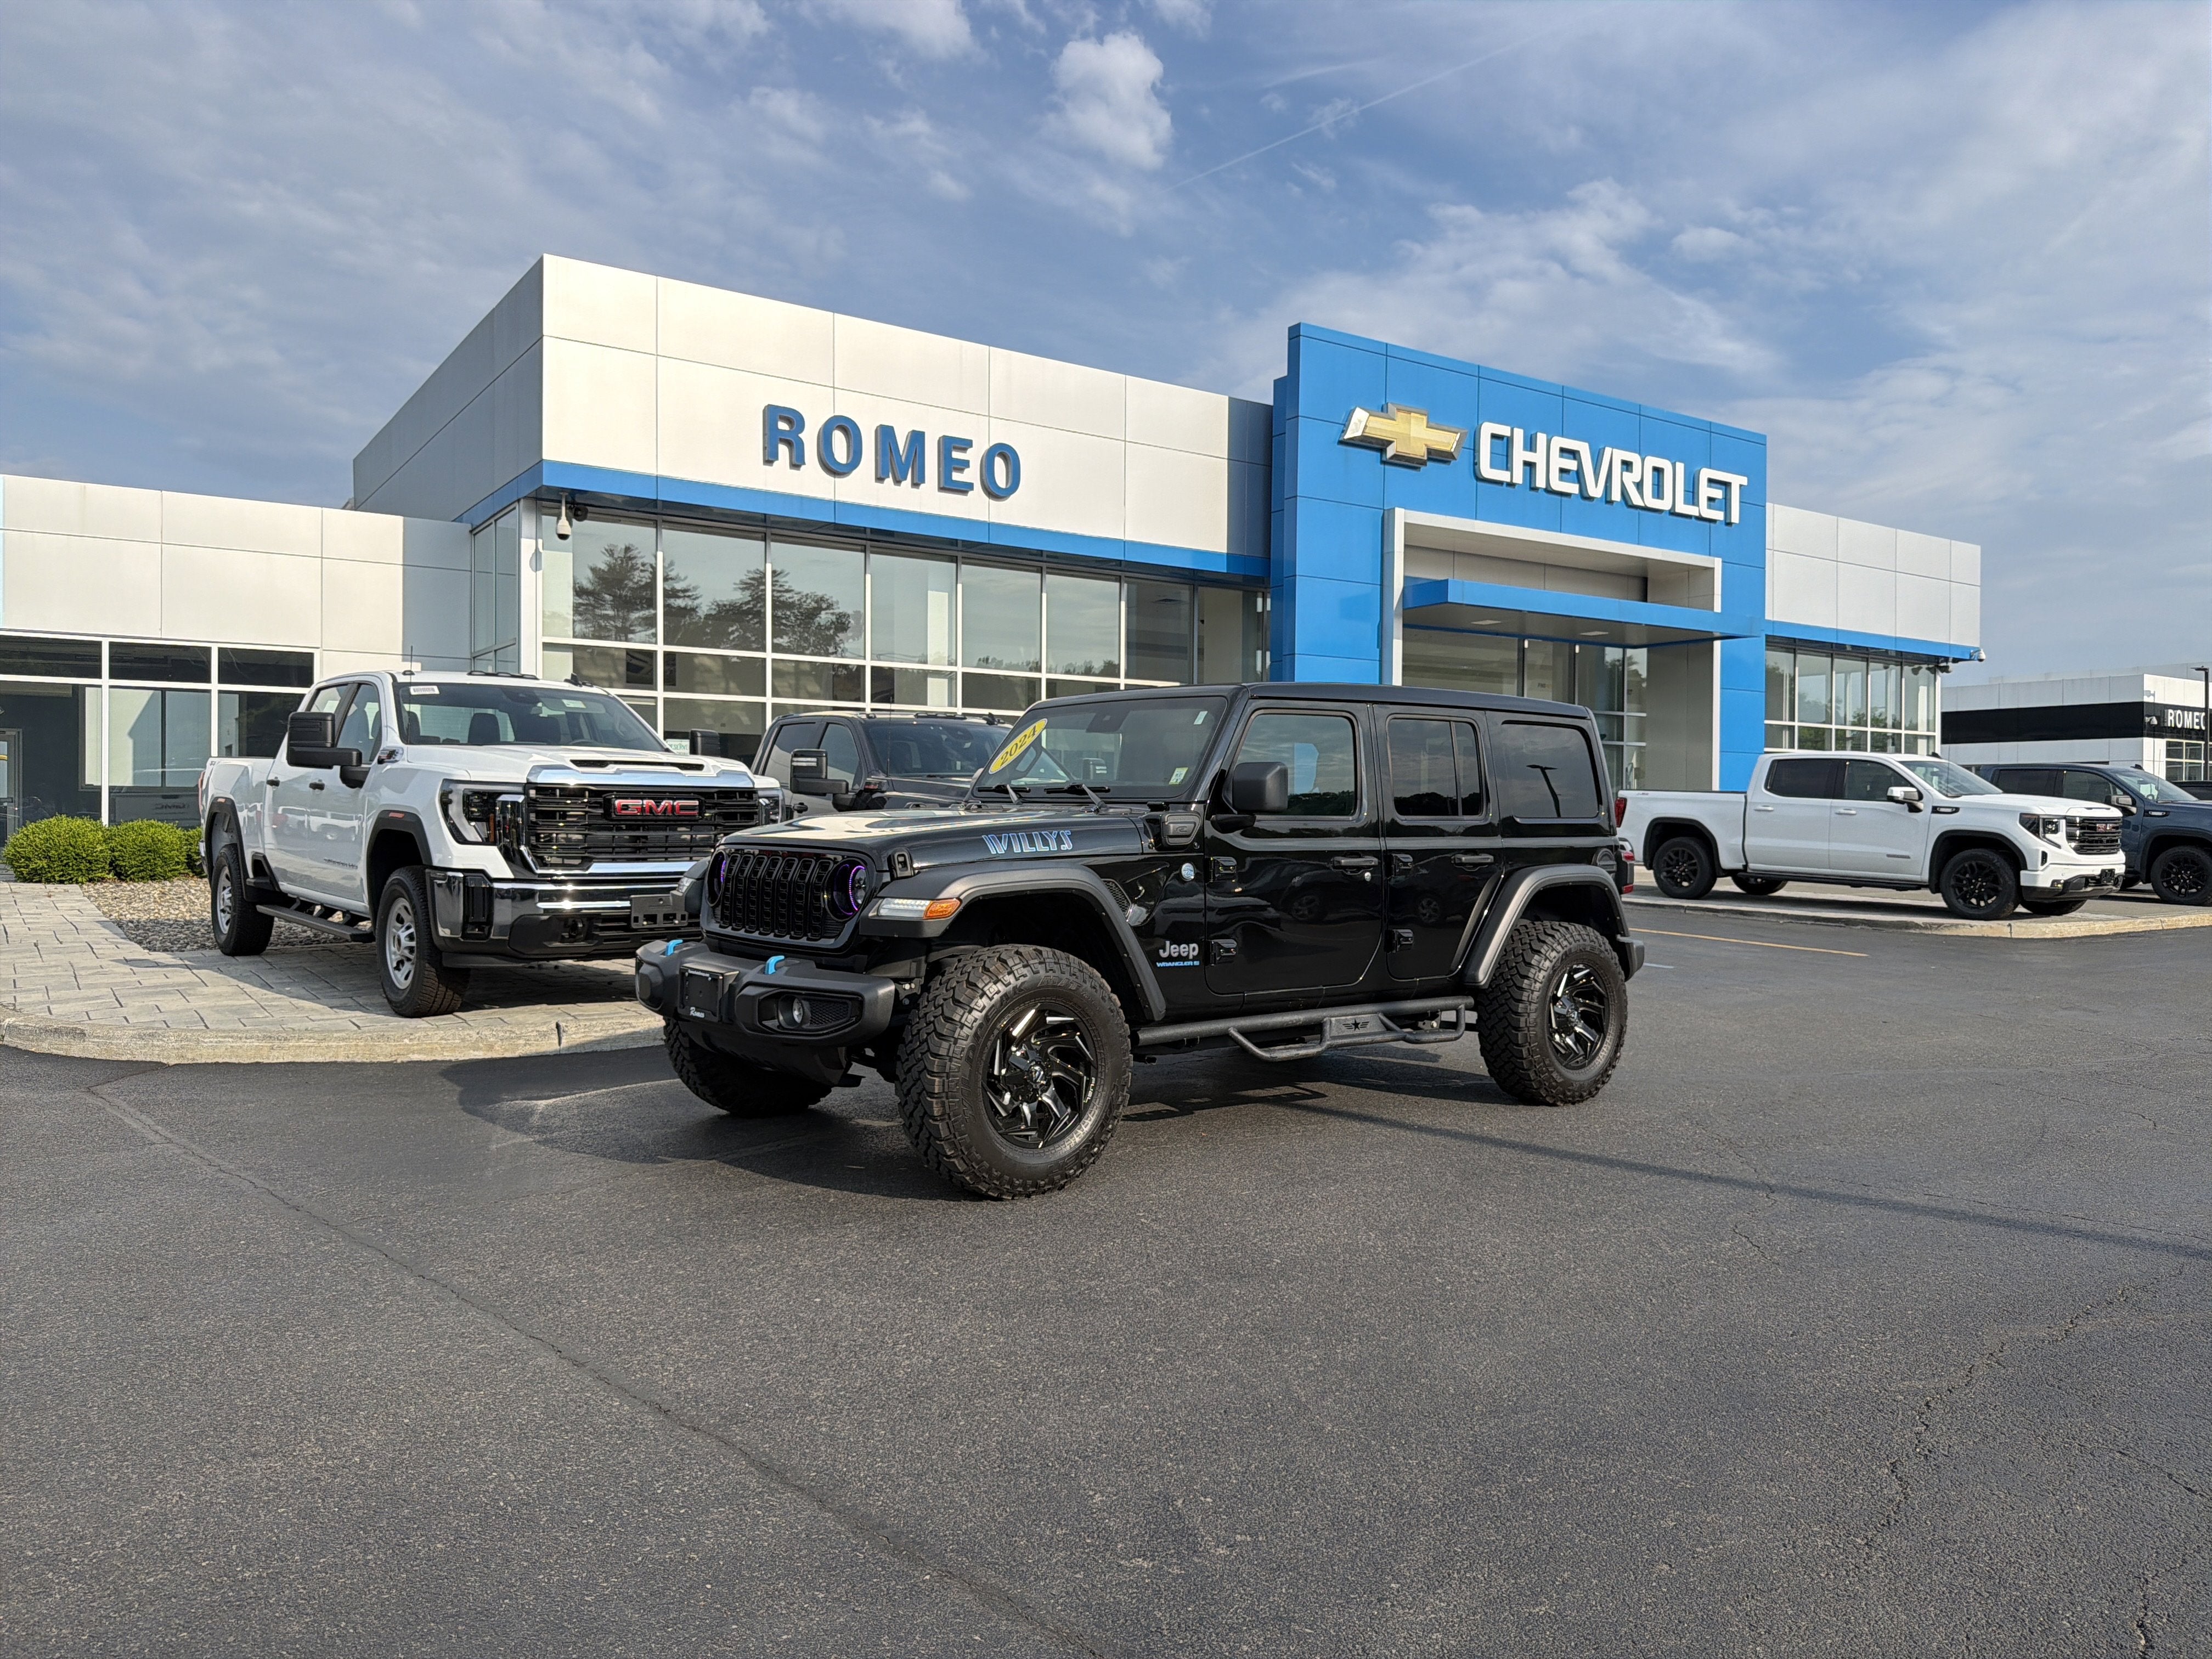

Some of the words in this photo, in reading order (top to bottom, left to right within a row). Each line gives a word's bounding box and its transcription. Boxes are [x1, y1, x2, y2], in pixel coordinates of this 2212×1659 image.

[763, 404, 1021, 501] ROMEO
[1476, 422, 1747, 525] CHEVROLET
[1000, 725, 1037, 767] 2024
[615, 799, 699, 816] GMC
[981, 830, 1073, 854] WILLYS
[1159, 940, 1199, 960] Jeep
